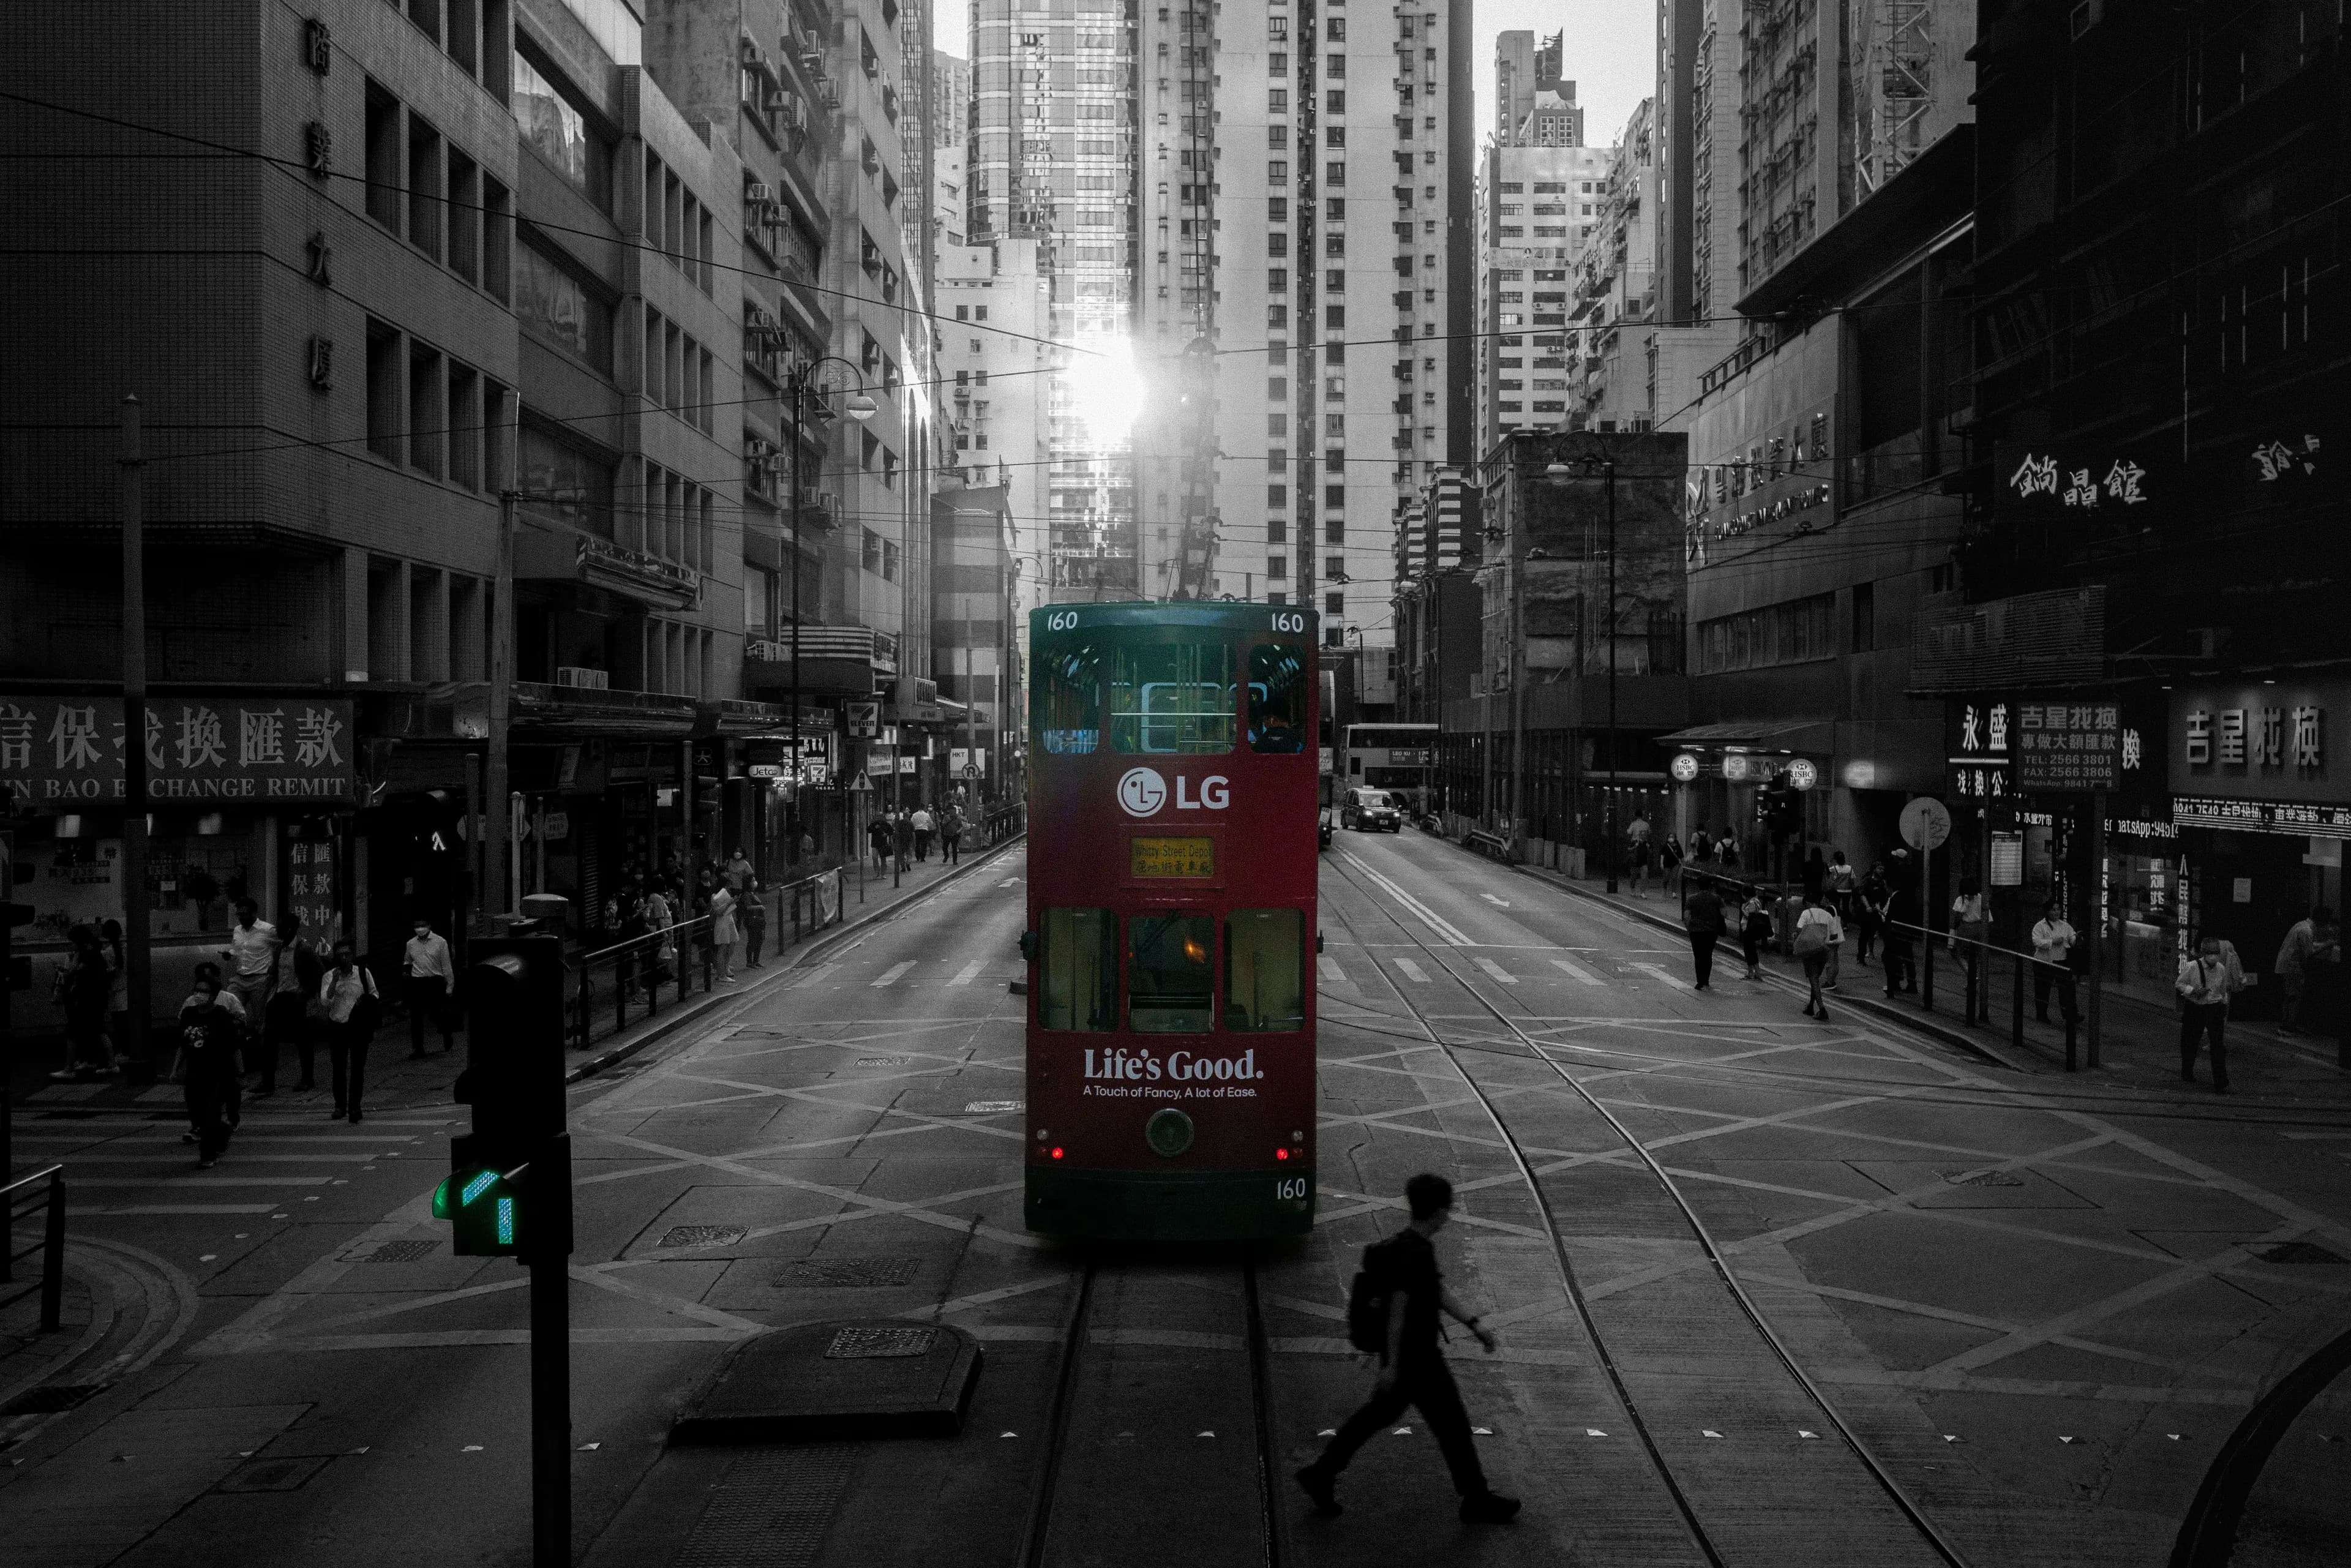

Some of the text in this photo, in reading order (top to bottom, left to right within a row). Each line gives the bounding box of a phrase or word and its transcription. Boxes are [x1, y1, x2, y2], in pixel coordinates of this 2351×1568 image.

[1048, 612, 1078, 631] 160
[1272, 613, 1303, 632] 160
[1963, 703, 2008, 751] 永盛
[2021, 706, 2117, 729] 吉星找換
[2186, 707, 2320, 766] 吉星找換
[2025, 754, 2111, 765] TEL: 2566 3801
[2024, 767, 2112, 777] FAX: 2566 3806
[45, 779, 100, 798] BAO
[114, 778, 255, 797] ECHANGE
[267, 778, 345, 796] REMIT
[1177, 775, 1229, 809] LG
[1957, 768, 2027, 798] 找換公
[1162, 845, 1187, 857] Street
[1084, 1048, 1264, 1080] Life's Good.
[1083, 1085, 1257, 1100] A Touch of Fancy, A lot of Ease.
[1277, 1177, 1305, 1200] 160
